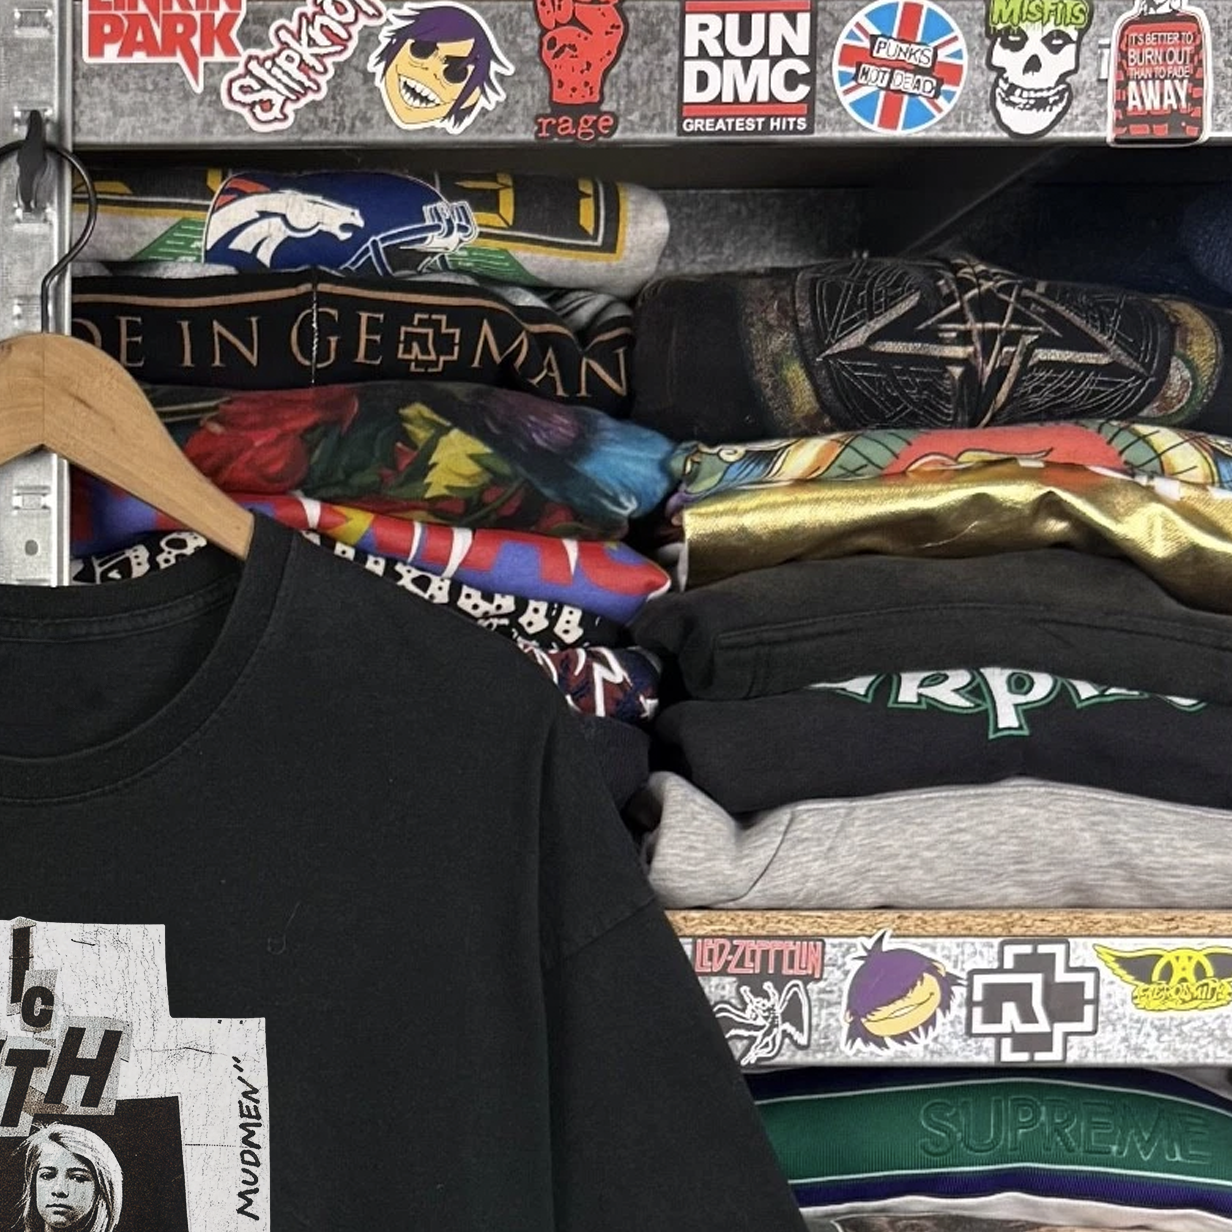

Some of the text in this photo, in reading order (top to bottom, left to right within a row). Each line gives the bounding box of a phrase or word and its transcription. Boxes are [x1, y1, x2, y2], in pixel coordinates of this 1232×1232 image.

[684, 13, 810, 56] RUN
[1145, 32, 1179, 45] BETTER
[1180, 31, 1194, 44] TO
[88, 13, 241, 86] PARK
[874, 38, 933, 66] PUNKS
[1128, 47, 1192, 66] BURN OUT
[683, 59, 811, 103] DMC
[892, 71, 937, 96] DEAD
[1129, 66, 1190, 79] THAN TO FADE
[1128, 80, 1189, 111] AWAY
[537, 114, 615, 140] rage
[682, 117, 808, 132] GREATEST HITS
[177, 315, 259, 368] IN
[920, 1096, 1212, 1163] SUPREME
